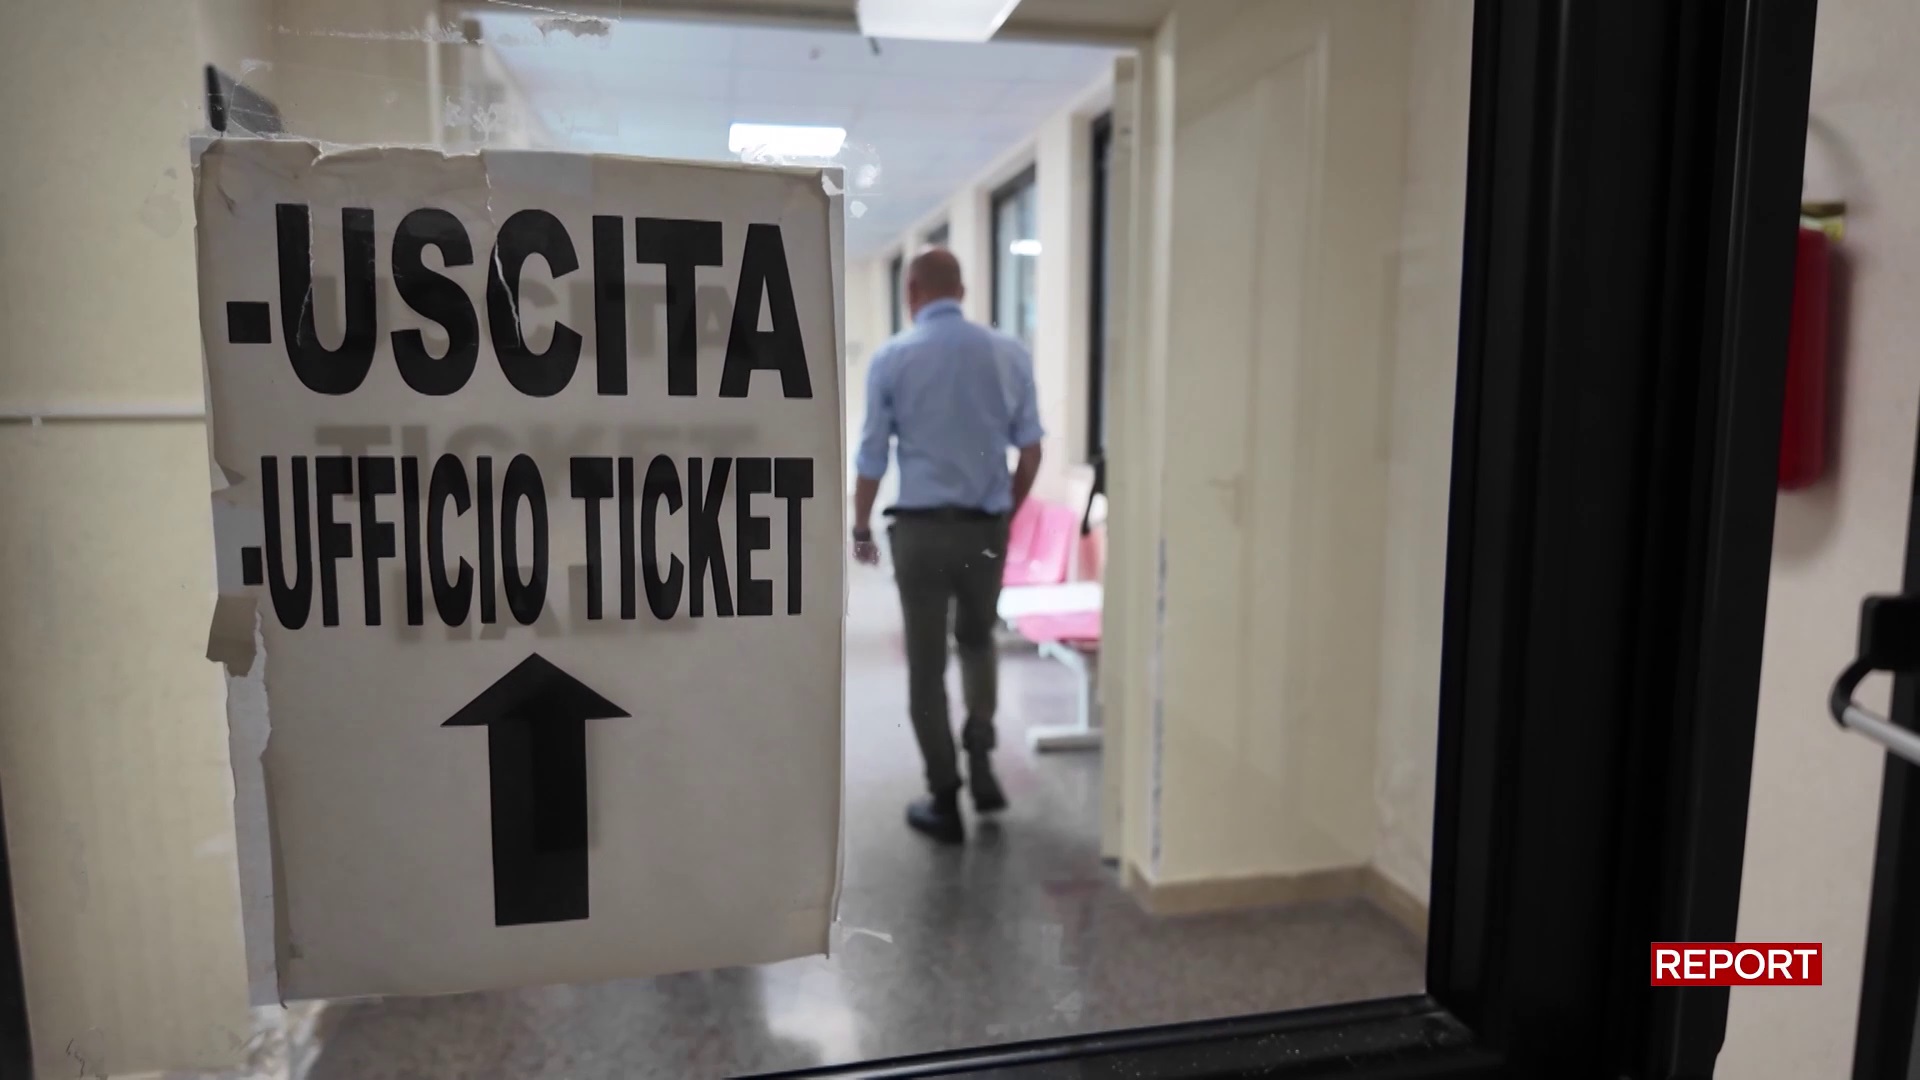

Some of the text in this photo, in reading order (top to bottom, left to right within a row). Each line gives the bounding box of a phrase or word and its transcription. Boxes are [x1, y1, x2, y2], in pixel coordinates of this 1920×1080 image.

[227, 204, 812, 398] -USCITA
[242, 453, 814, 630] -UFFICIO TICKET
